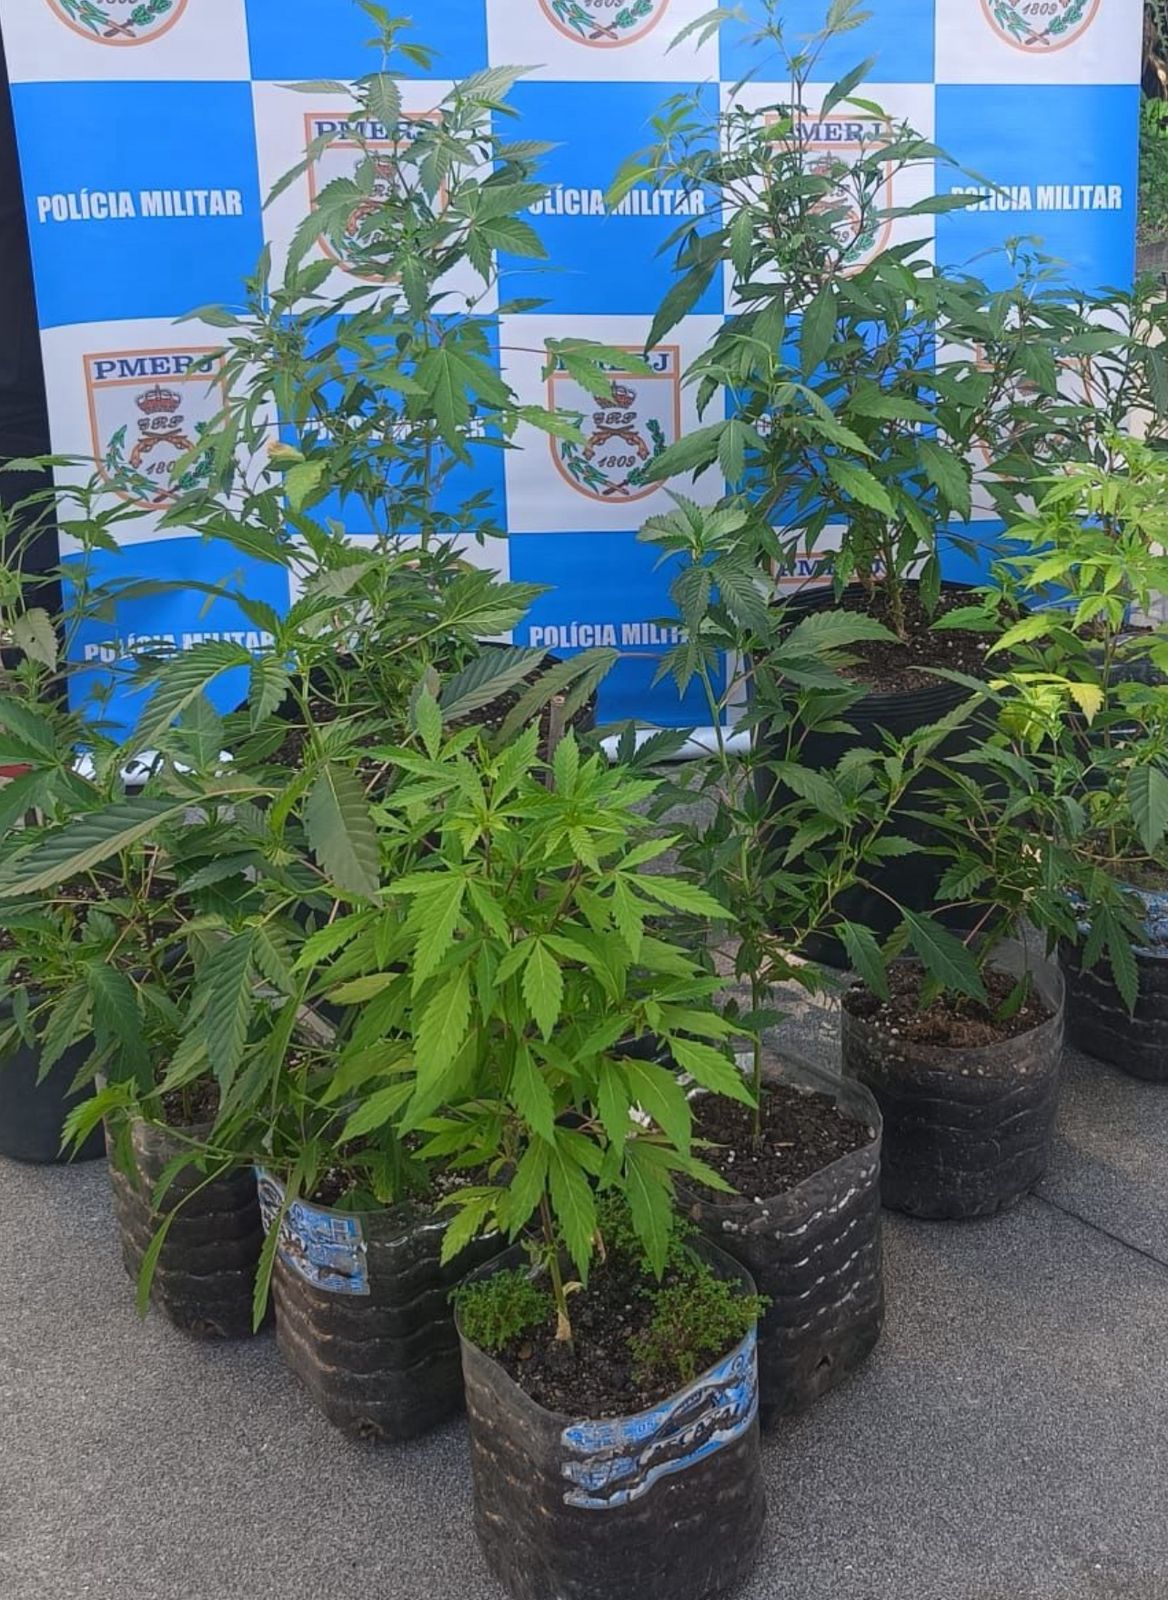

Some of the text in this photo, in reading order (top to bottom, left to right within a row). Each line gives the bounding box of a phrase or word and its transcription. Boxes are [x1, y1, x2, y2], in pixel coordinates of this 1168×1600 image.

[1022, 2, 1058, 16] 1809
[36, 187, 243, 223] POLÍCIA MILITAR
[1036, 184, 1123, 211] MILITAR
[145, 460, 176, 475] 180
[597, 455, 636, 468] 1809
[529, 621, 617, 650] POLÍCIA
